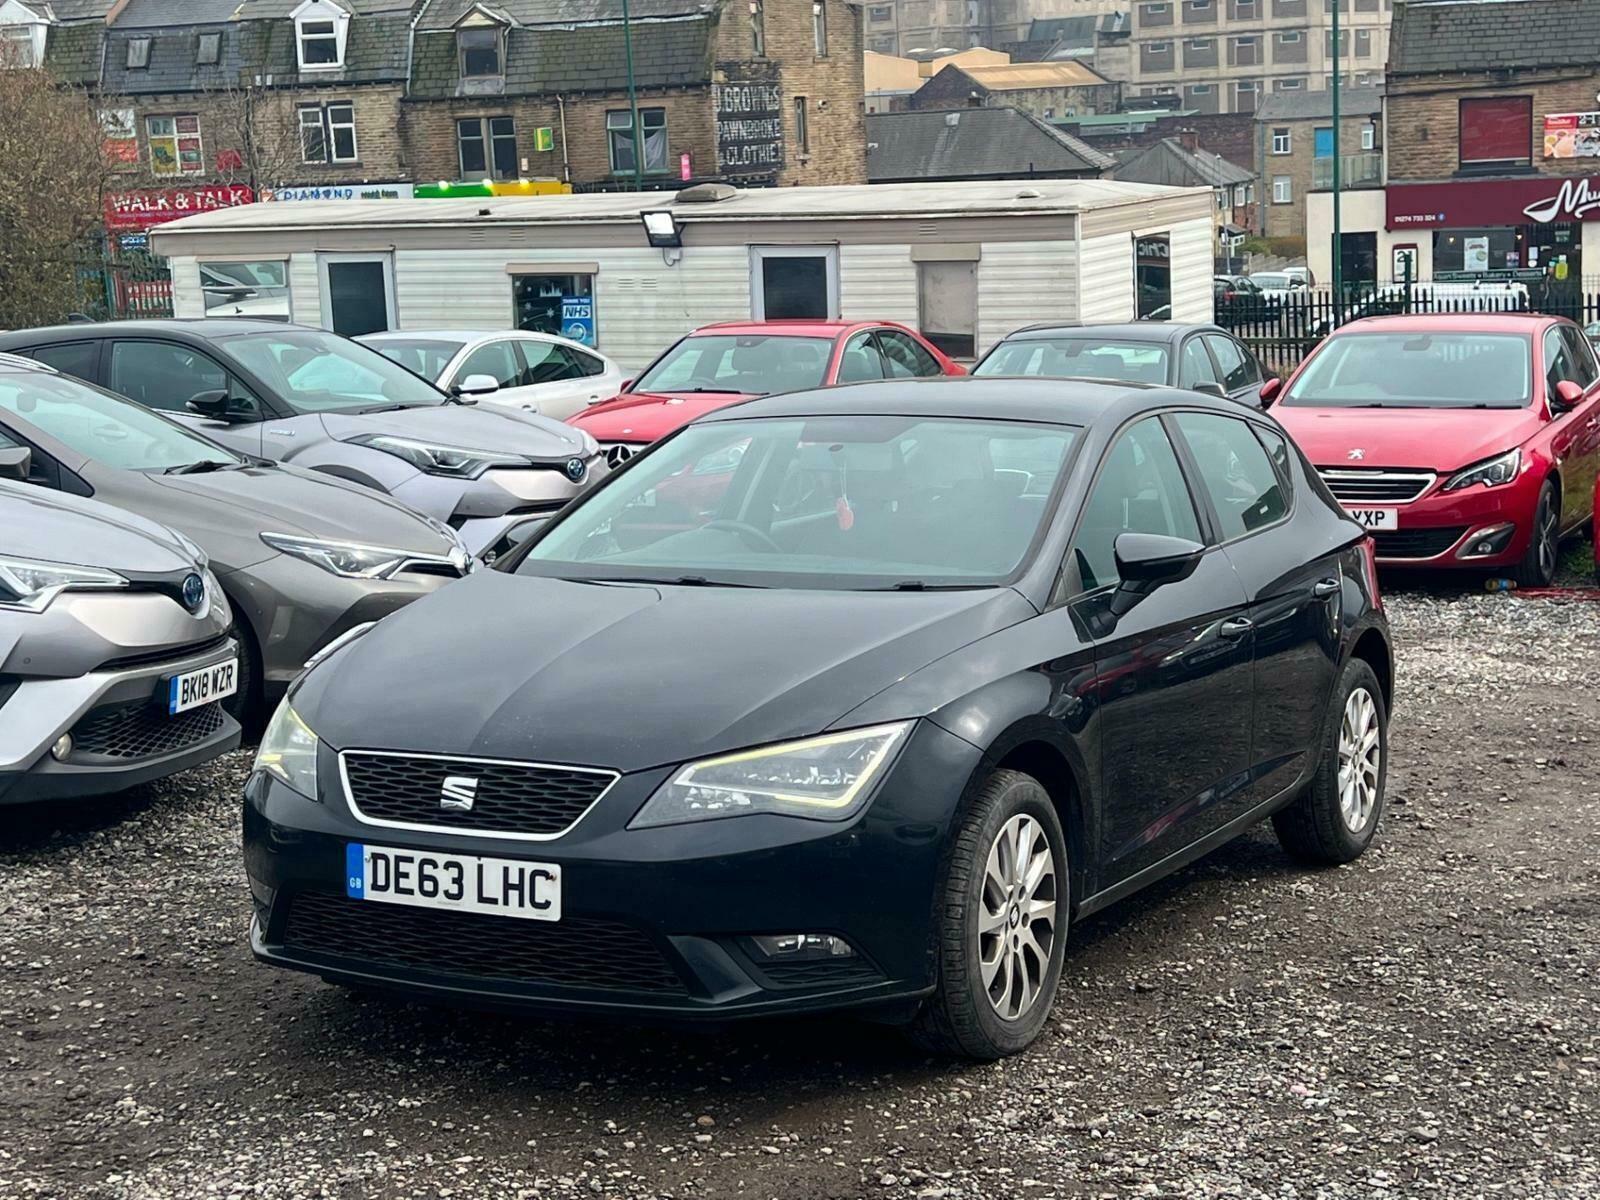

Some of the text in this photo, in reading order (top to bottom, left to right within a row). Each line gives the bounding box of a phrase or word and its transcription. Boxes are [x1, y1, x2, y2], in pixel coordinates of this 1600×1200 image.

[112, 190, 243, 212] WALK & TALK
[564, 306, 590, 318] NHS
[181, 664, 233, 705] BK18 WZR
[350, 877, 362, 889] GB
[370, 852, 551, 910] DE63 LHC
